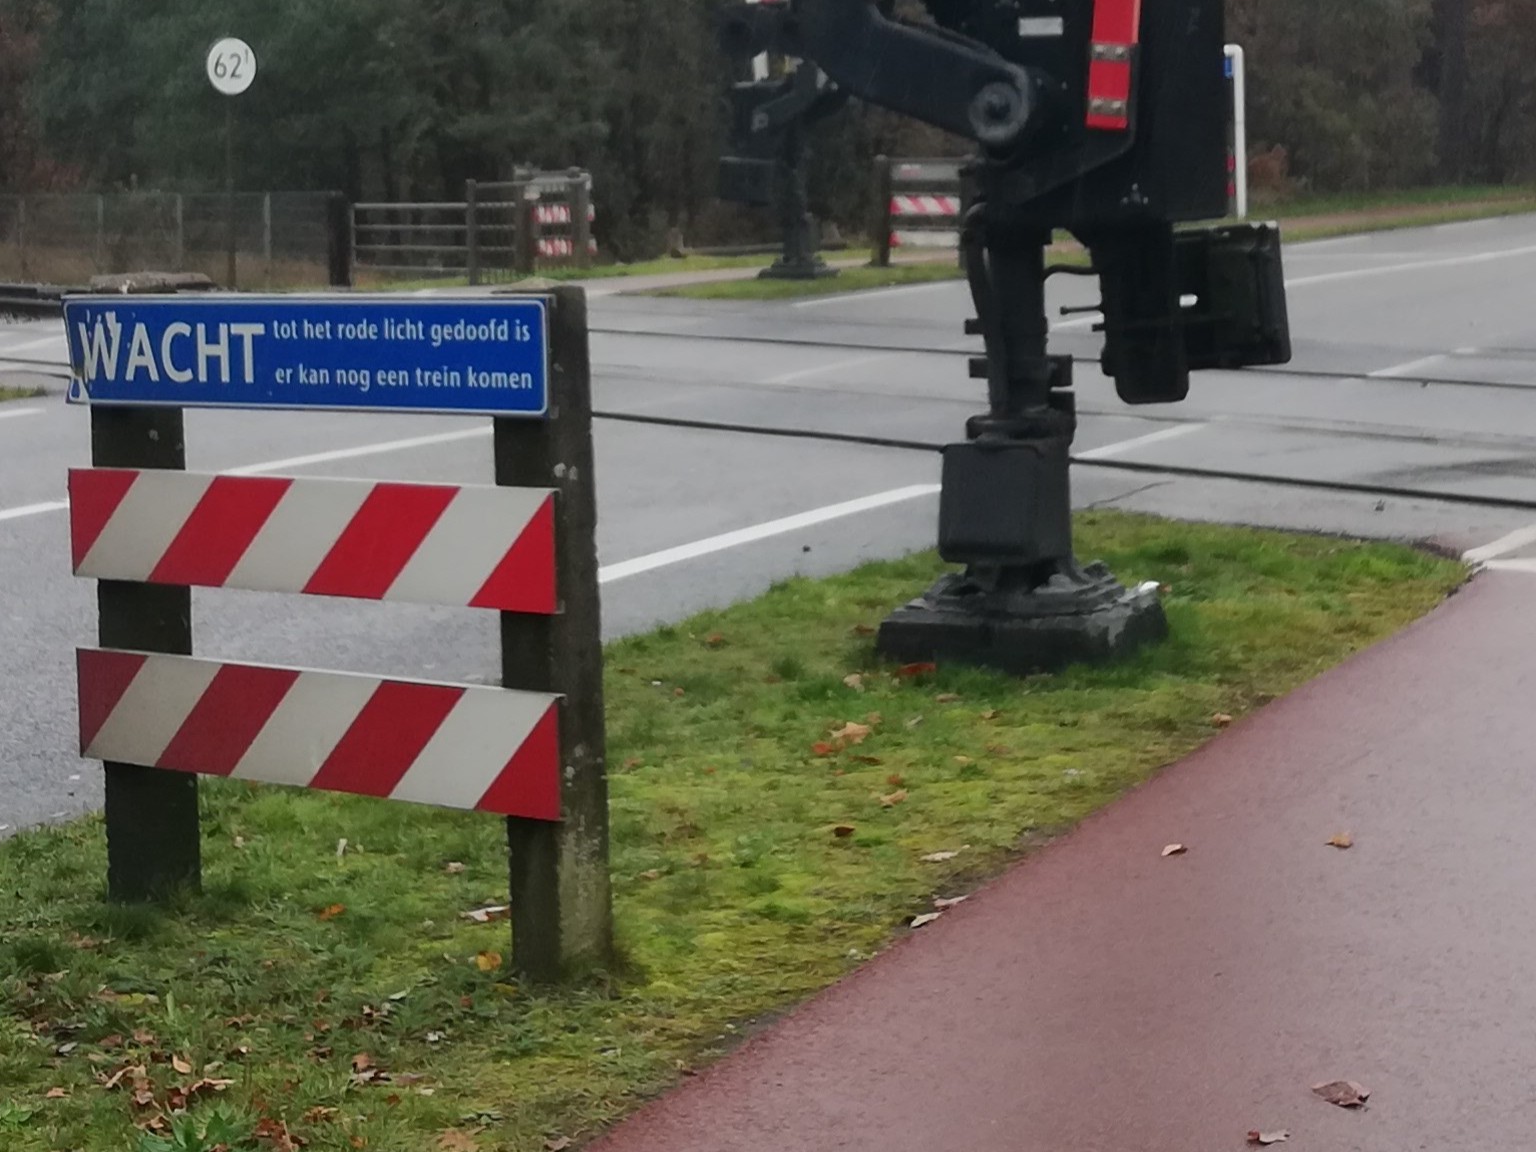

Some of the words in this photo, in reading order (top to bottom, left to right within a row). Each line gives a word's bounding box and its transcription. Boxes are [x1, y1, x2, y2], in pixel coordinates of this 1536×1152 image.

[273, 319, 298, 340] tot
[303, 318, 332, 340] het
[337, 318, 379, 340] rode
[384, 318, 425, 341] licht
[430, 318, 509, 348] gedoofd
[515, 318, 531, 342] is
[78, 321, 266, 384] WACHT
[275, 367, 293, 385] er
[298, 363, 330, 385] kan
[335, 368, 371, 392] nog
[376, 369, 410, 387] een
[415, 365, 462, 388] trein
[467, 365, 533, 389] komen
